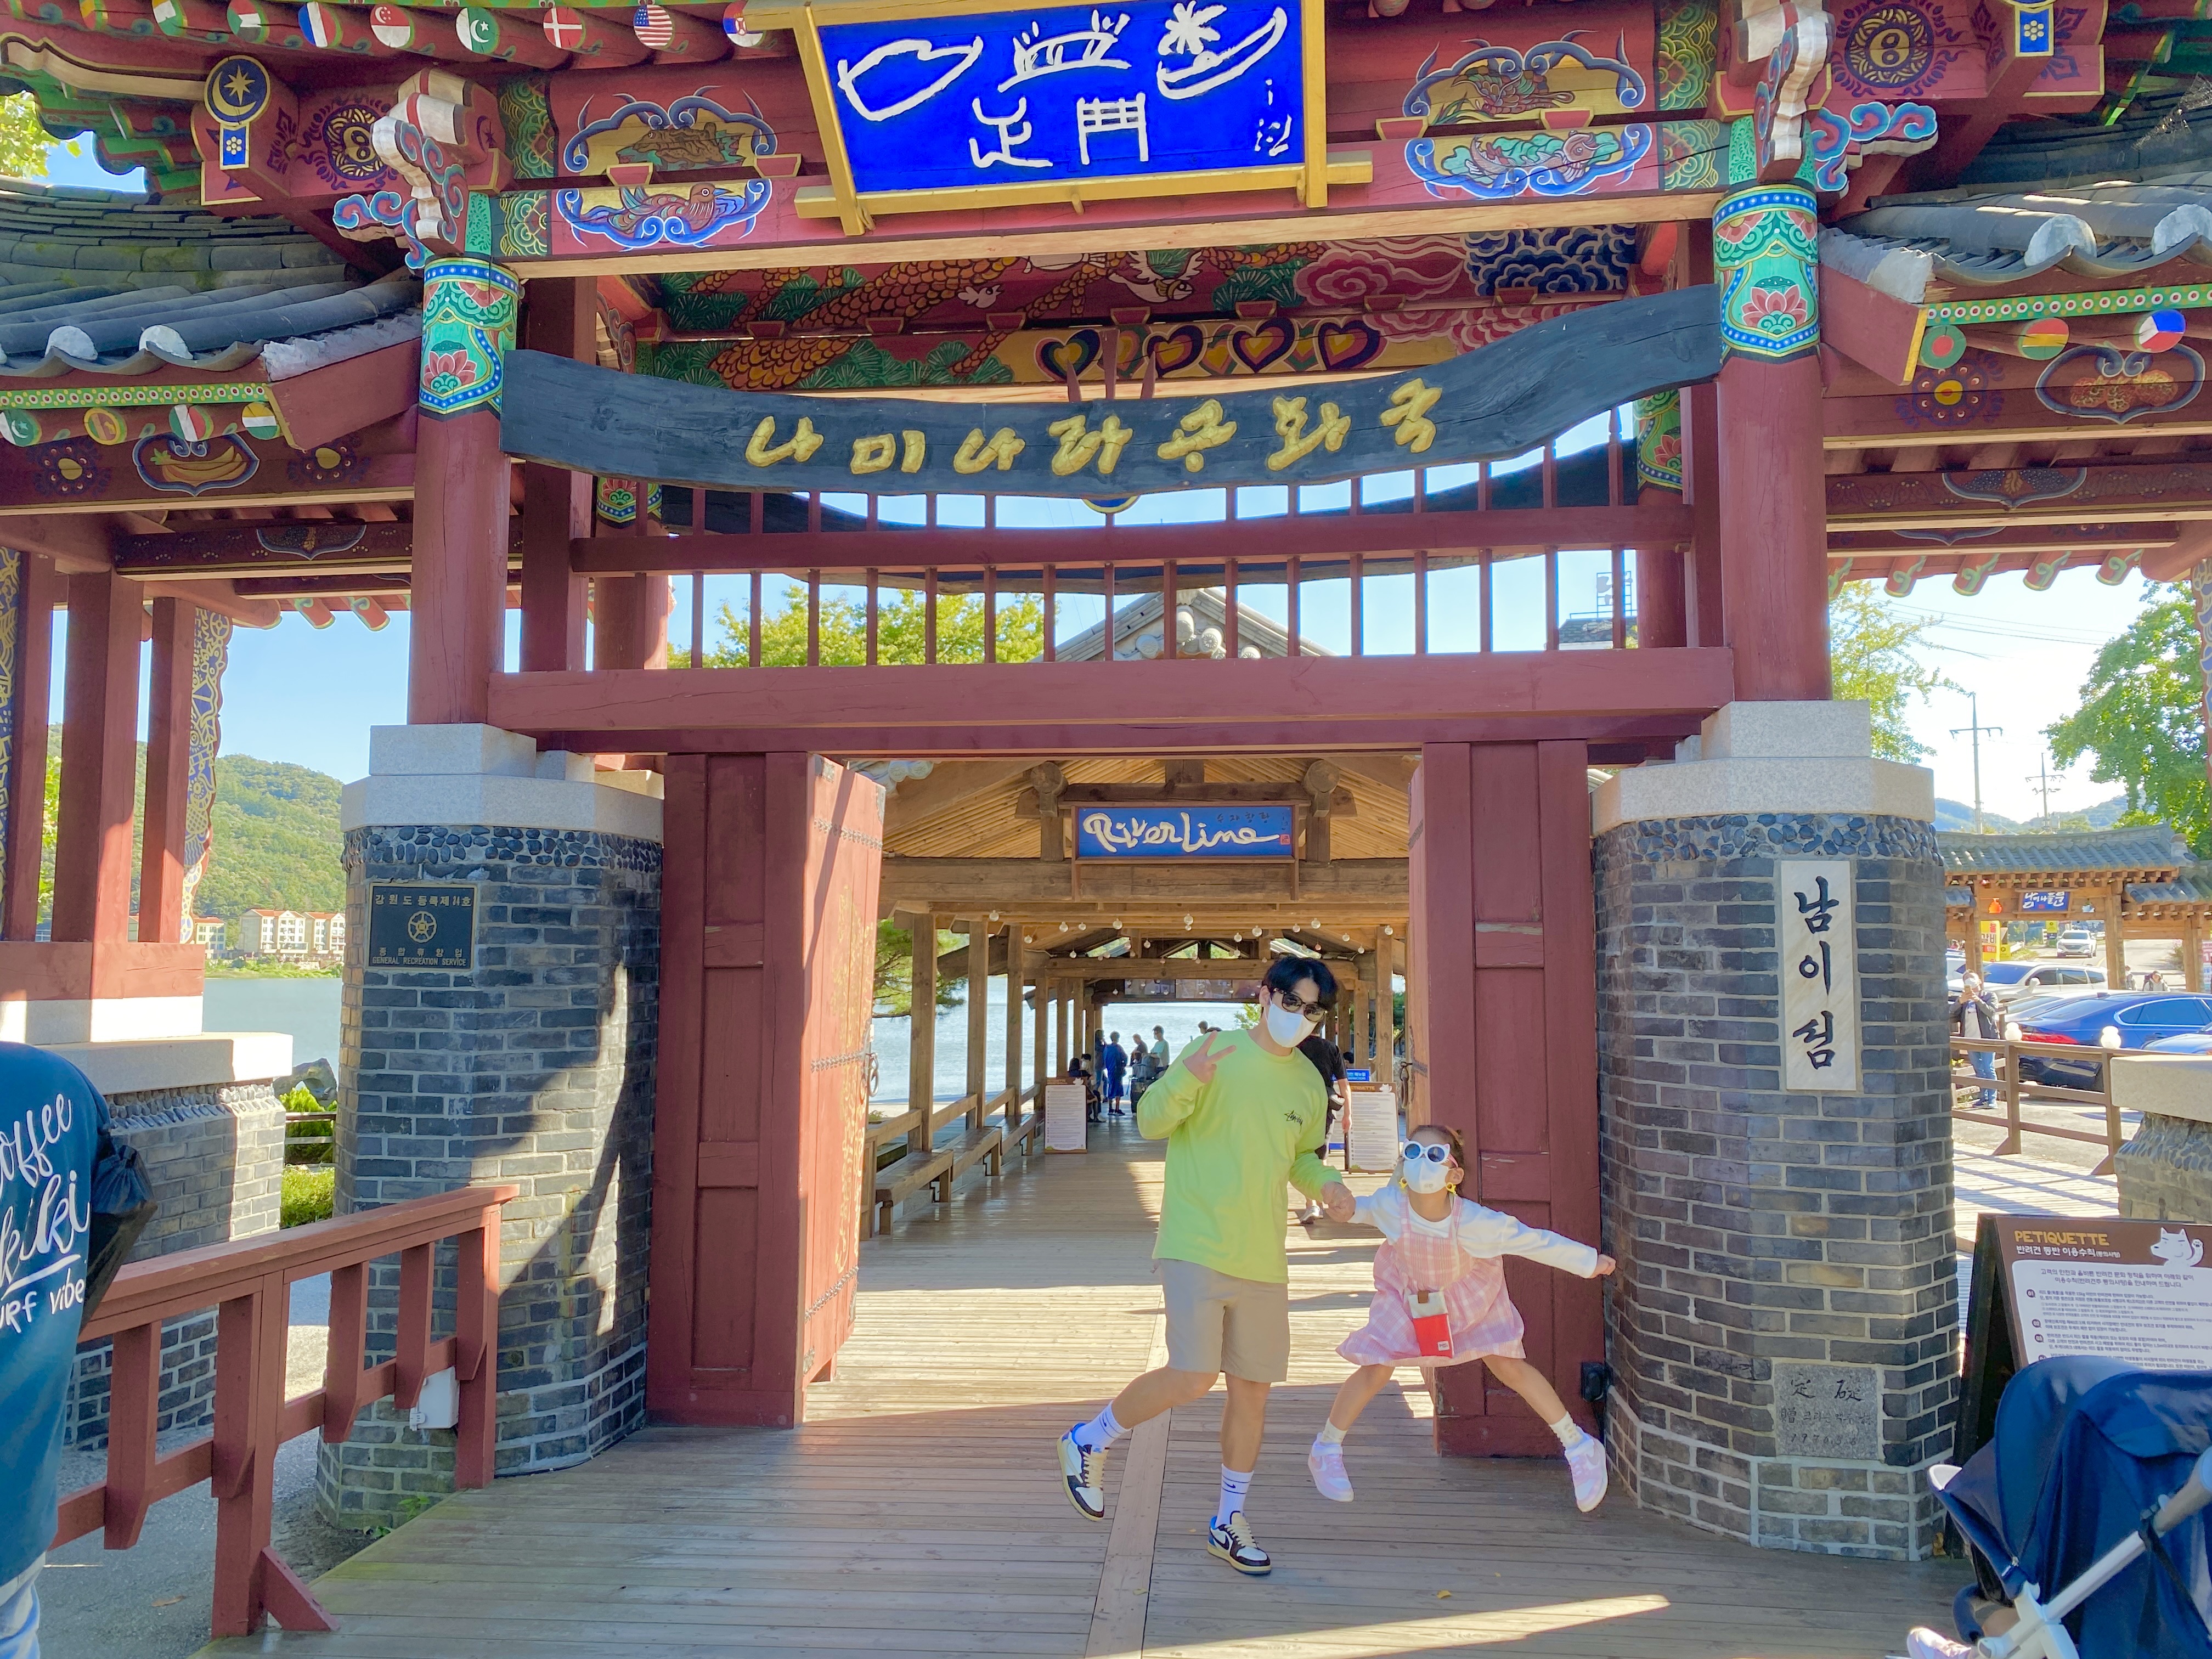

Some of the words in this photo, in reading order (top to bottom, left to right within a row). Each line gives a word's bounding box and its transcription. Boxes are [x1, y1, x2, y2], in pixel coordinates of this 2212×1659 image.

[375, 894, 413, 906] 강원도
[379, 947, 462, 958] 종합휴양업
[372, 956, 400, 965] GENERAL
[403, 957, 438, 966] RECREATION
[442, 958, 467, 967] SERVICE
[1793, 876, 1840, 1070] 남이섬
[0, 1093, 71, 1189] offee
[2014, 1230, 2110, 1246] PETIQUETTE
[2016, 1245, 2042, 1255] 반려견
[2044, 1247, 2061, 1256] 동반
